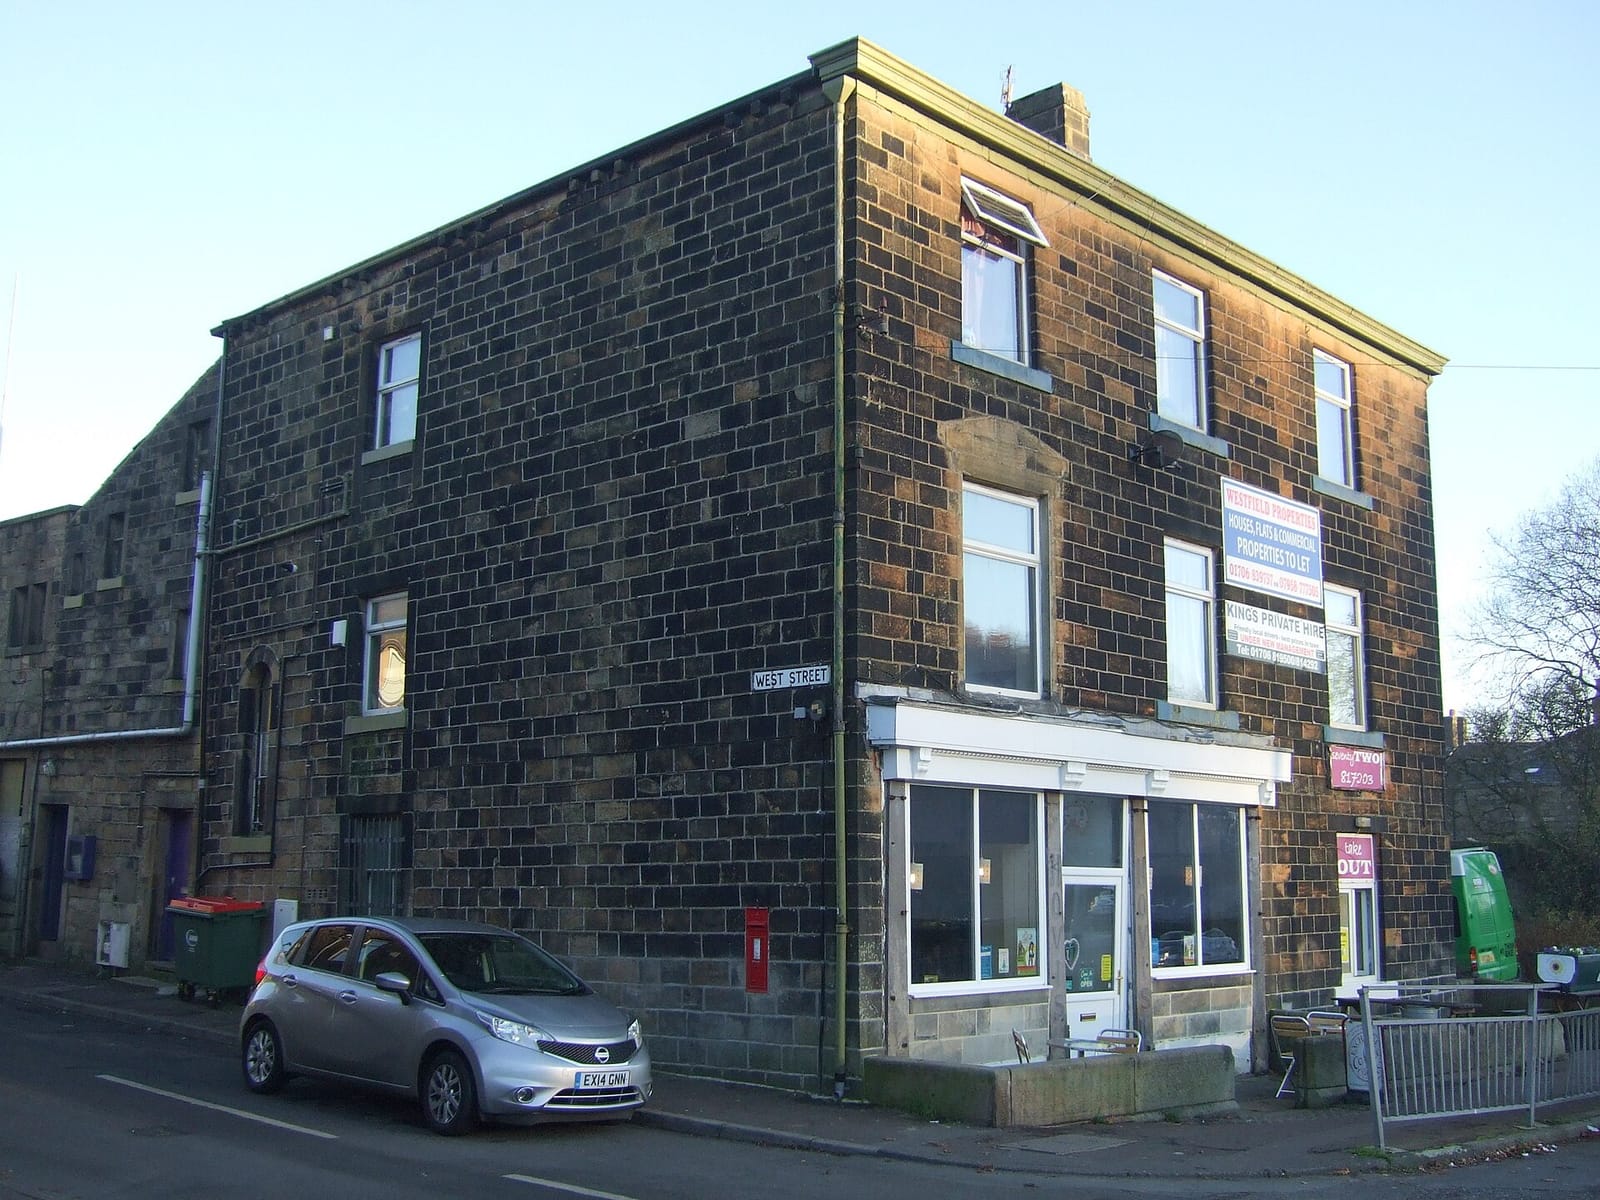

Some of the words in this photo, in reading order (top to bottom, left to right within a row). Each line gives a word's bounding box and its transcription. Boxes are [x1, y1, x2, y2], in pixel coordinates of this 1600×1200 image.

[1226, 488, 1270, 515] WESTFIELD
[1272, 500, 1316, 530] PROPERTIES
[1228, 512, 1255, 536] HOUSES,
[1256, 521, 1273, 540] FLATS
[1274, 527, 1278, 542] &
[1279, 529, 1316, 552] COMMERCIAL
[1237, 537, 1284, 566] PROPERTIES
[1286, 552, 1296, 569] TO
[1297, 556, 1310, 573] LET
[1262, 612, 1300, 633] PRIVATE
[1304, 623, 1325, 639] HIRE
[1240, 634, 1261, 646] UNDER
[1276, 642, 1314, 657] MANAGEMENT
[756, 673, 783, 687] WEST
[789, 668, 827, 684] STREET
[1345, 842, 1362, 856] take
[1338, 859, 1371, 874] OUT
[584, 1074, 606, 1086] EX14
[608, 1073, 626, 1085] GNN
